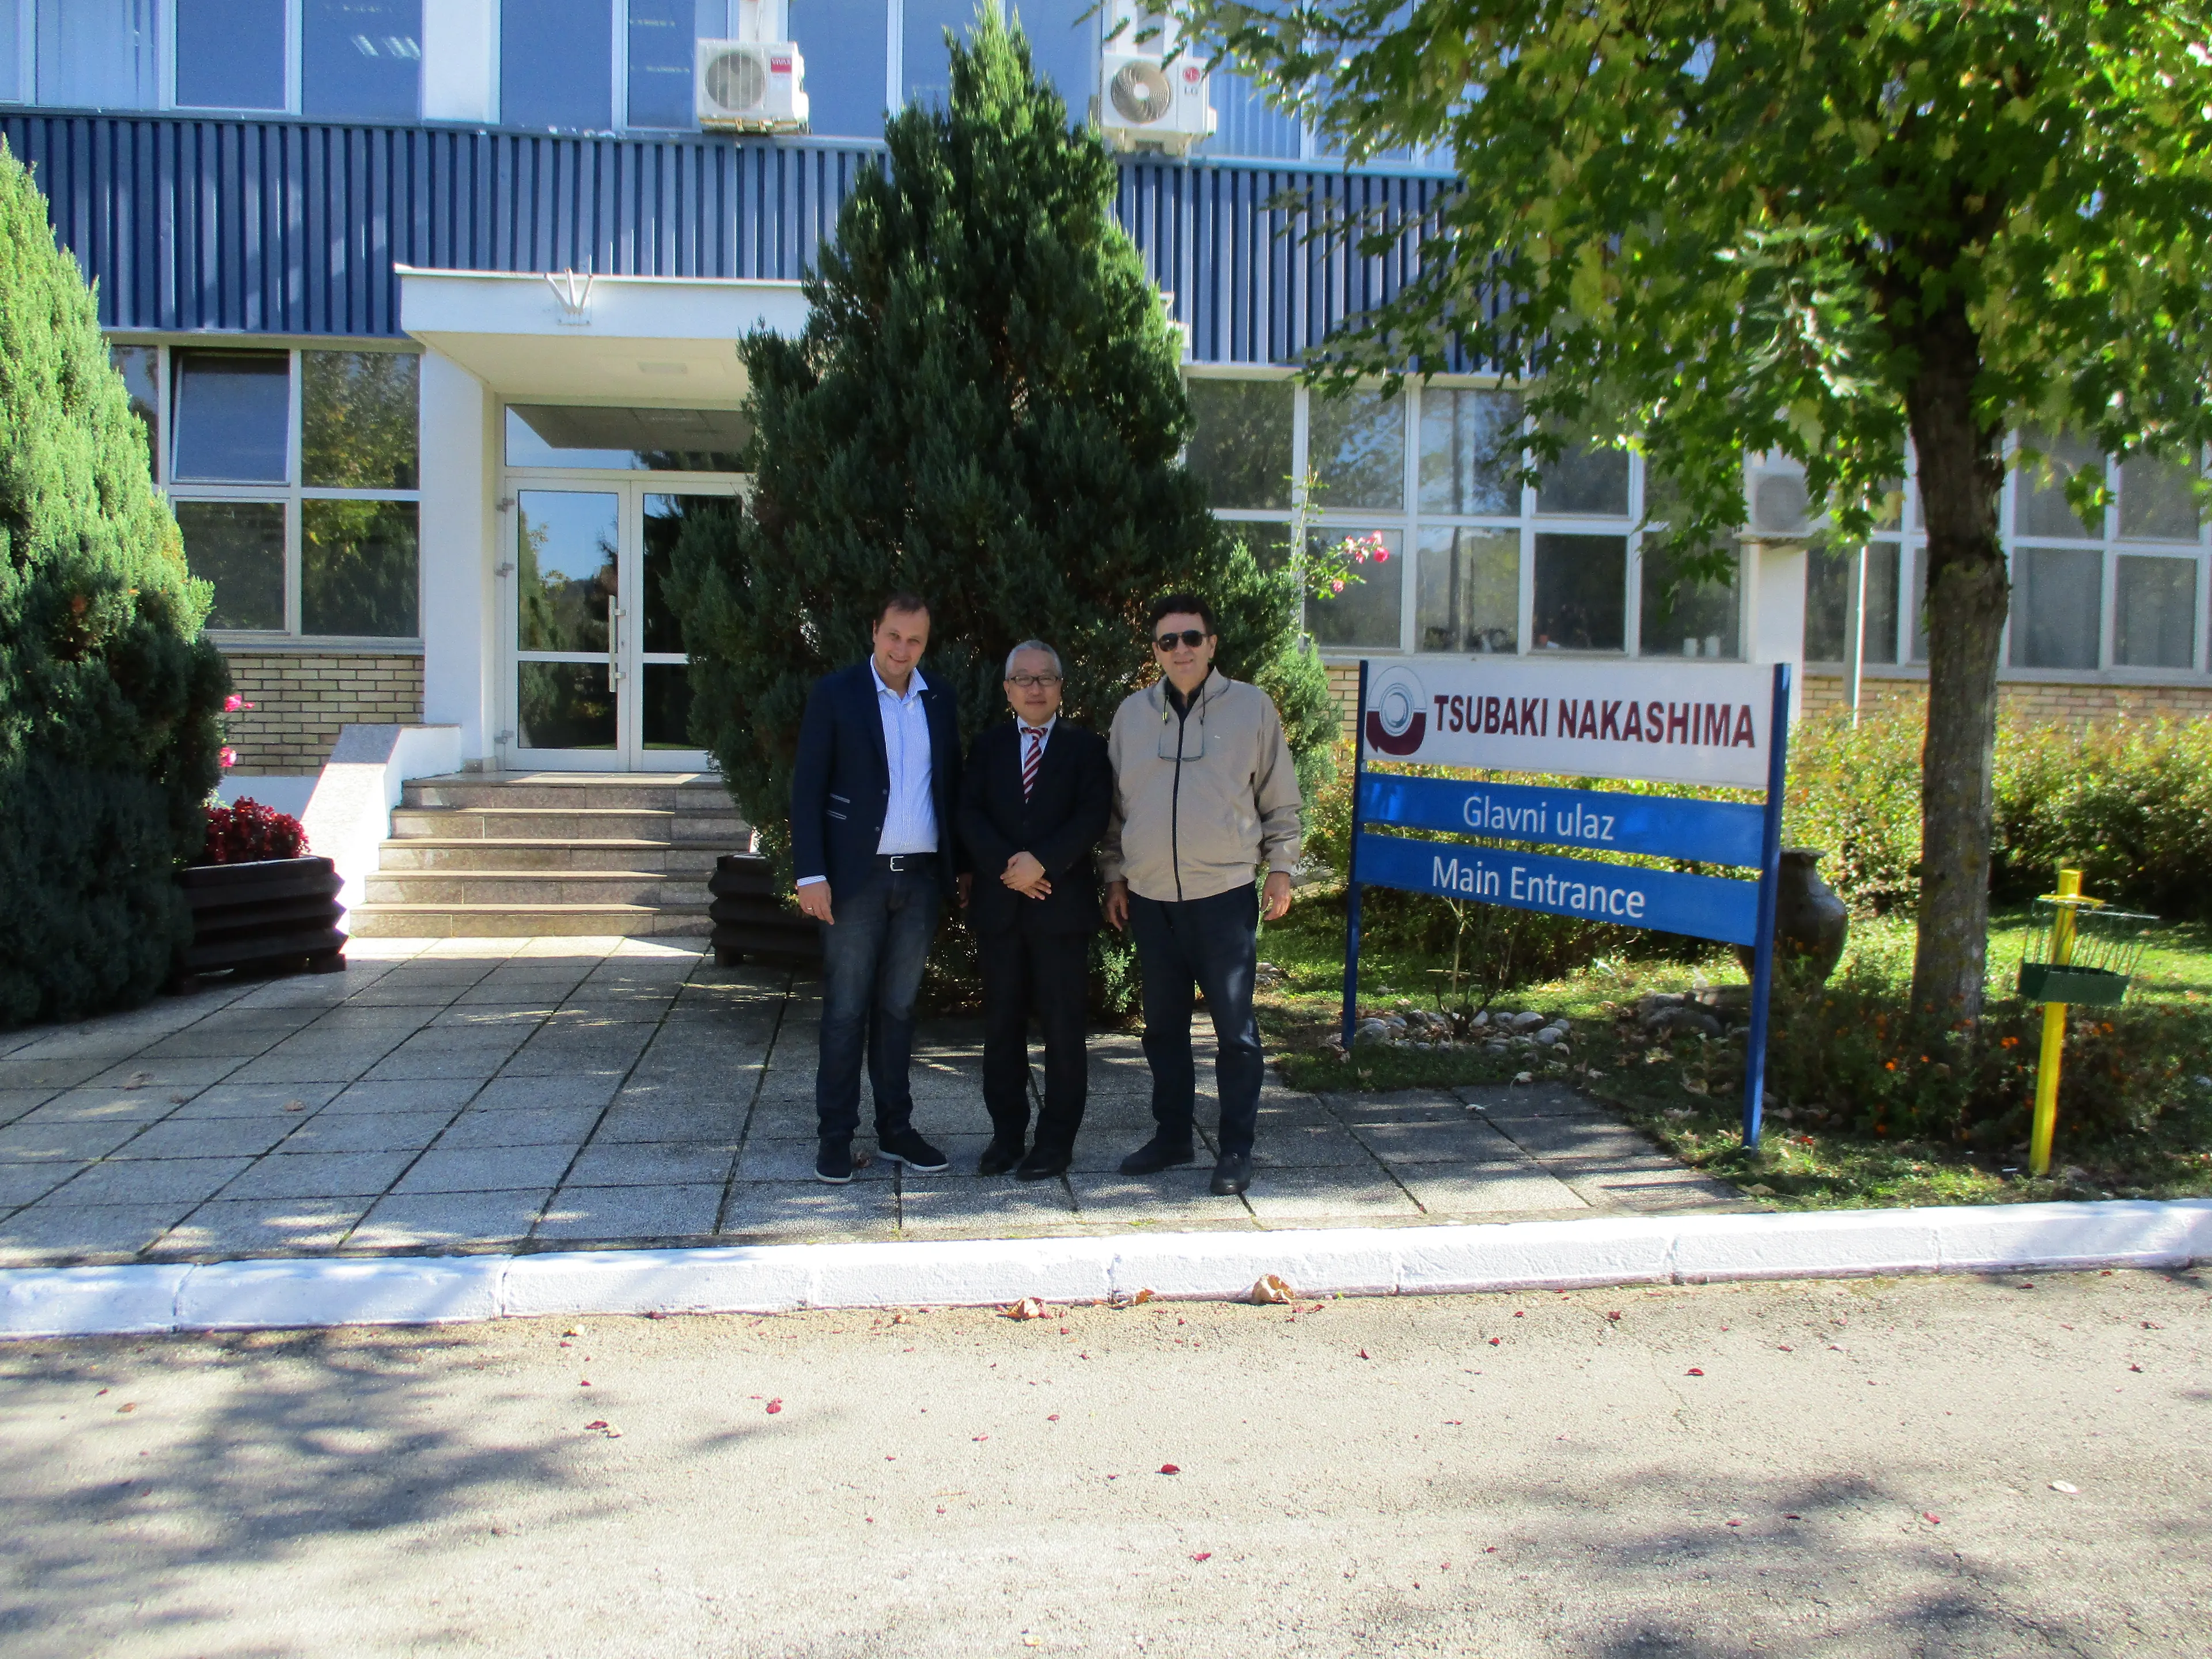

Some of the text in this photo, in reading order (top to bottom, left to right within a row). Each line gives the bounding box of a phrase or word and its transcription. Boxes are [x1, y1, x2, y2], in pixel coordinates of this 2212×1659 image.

[1434, 694, 1756, 748] TSUBAKI NAKASHIMA
[1463, 795, 1615, 841] Glavni ulaz
[1433, 855, 1646, 919] Main Entrance
